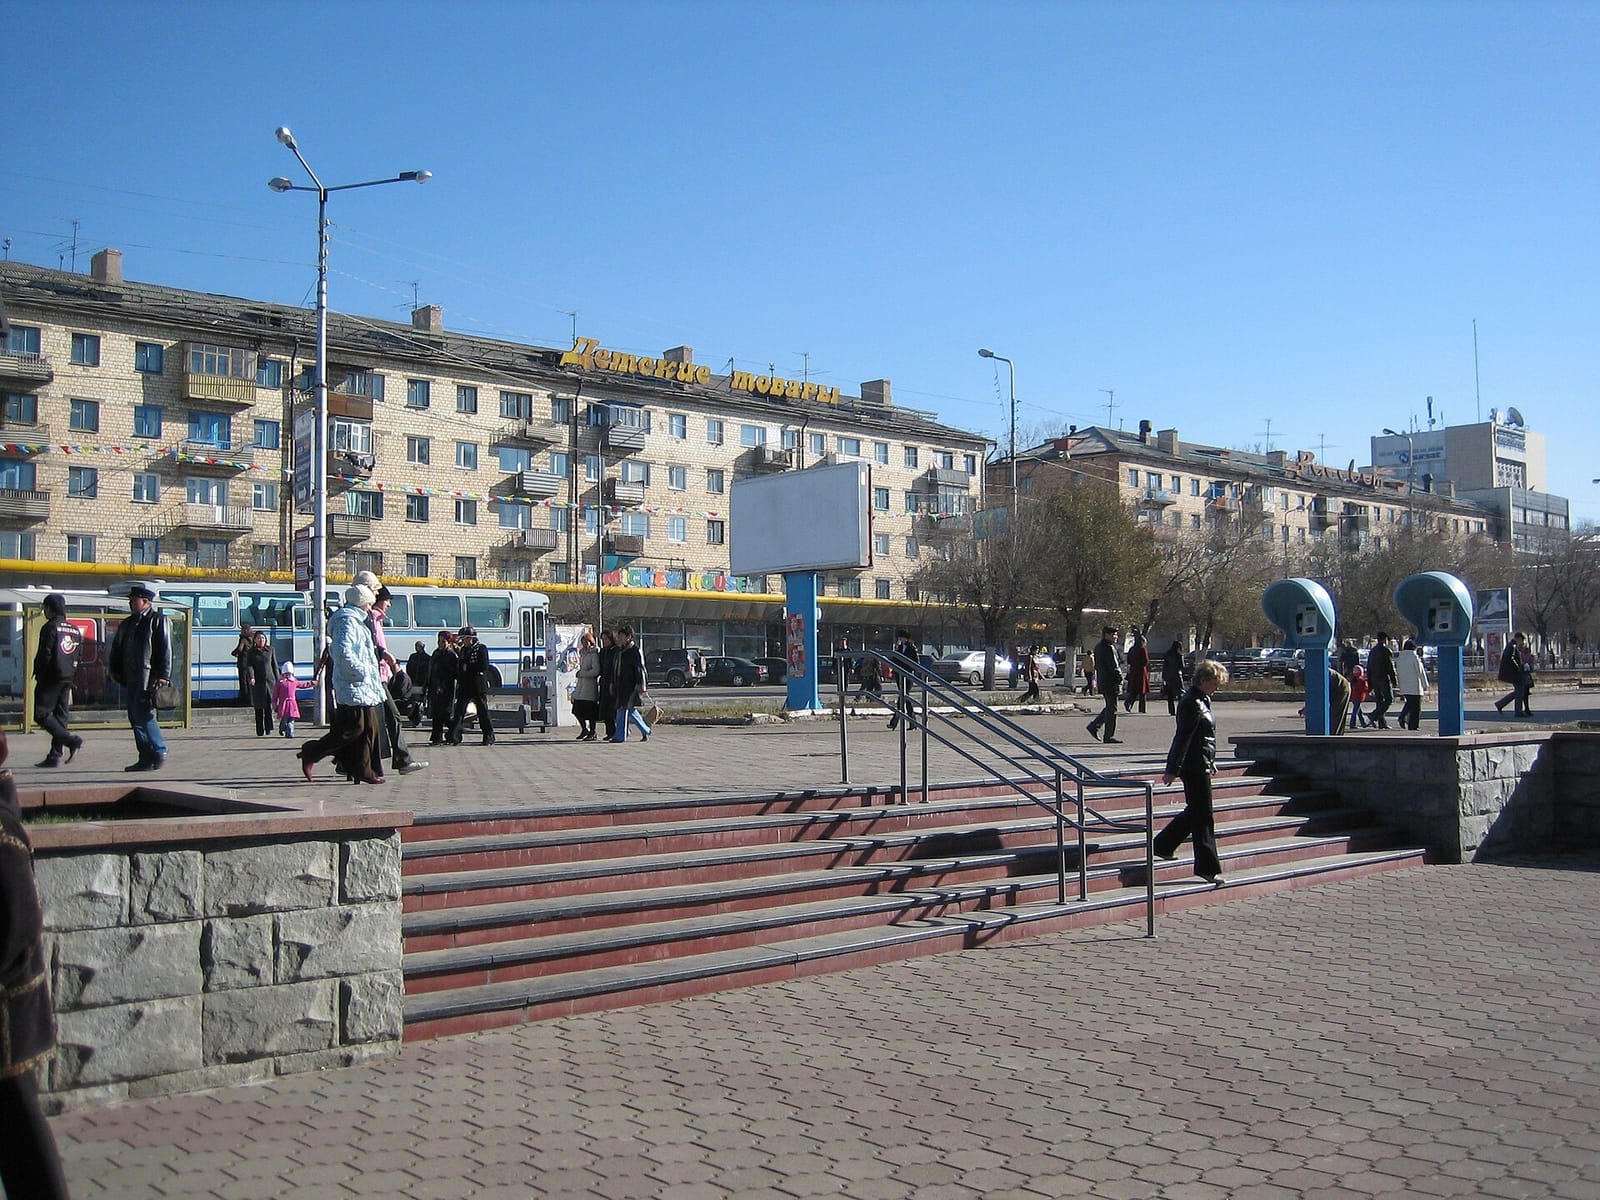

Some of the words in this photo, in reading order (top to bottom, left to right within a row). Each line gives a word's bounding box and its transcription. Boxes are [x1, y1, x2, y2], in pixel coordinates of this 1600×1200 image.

[559, 337, 712, 385] Детские
[730, 370, 841, 405] товары
[602, 568, 686, 590] MICKEY
